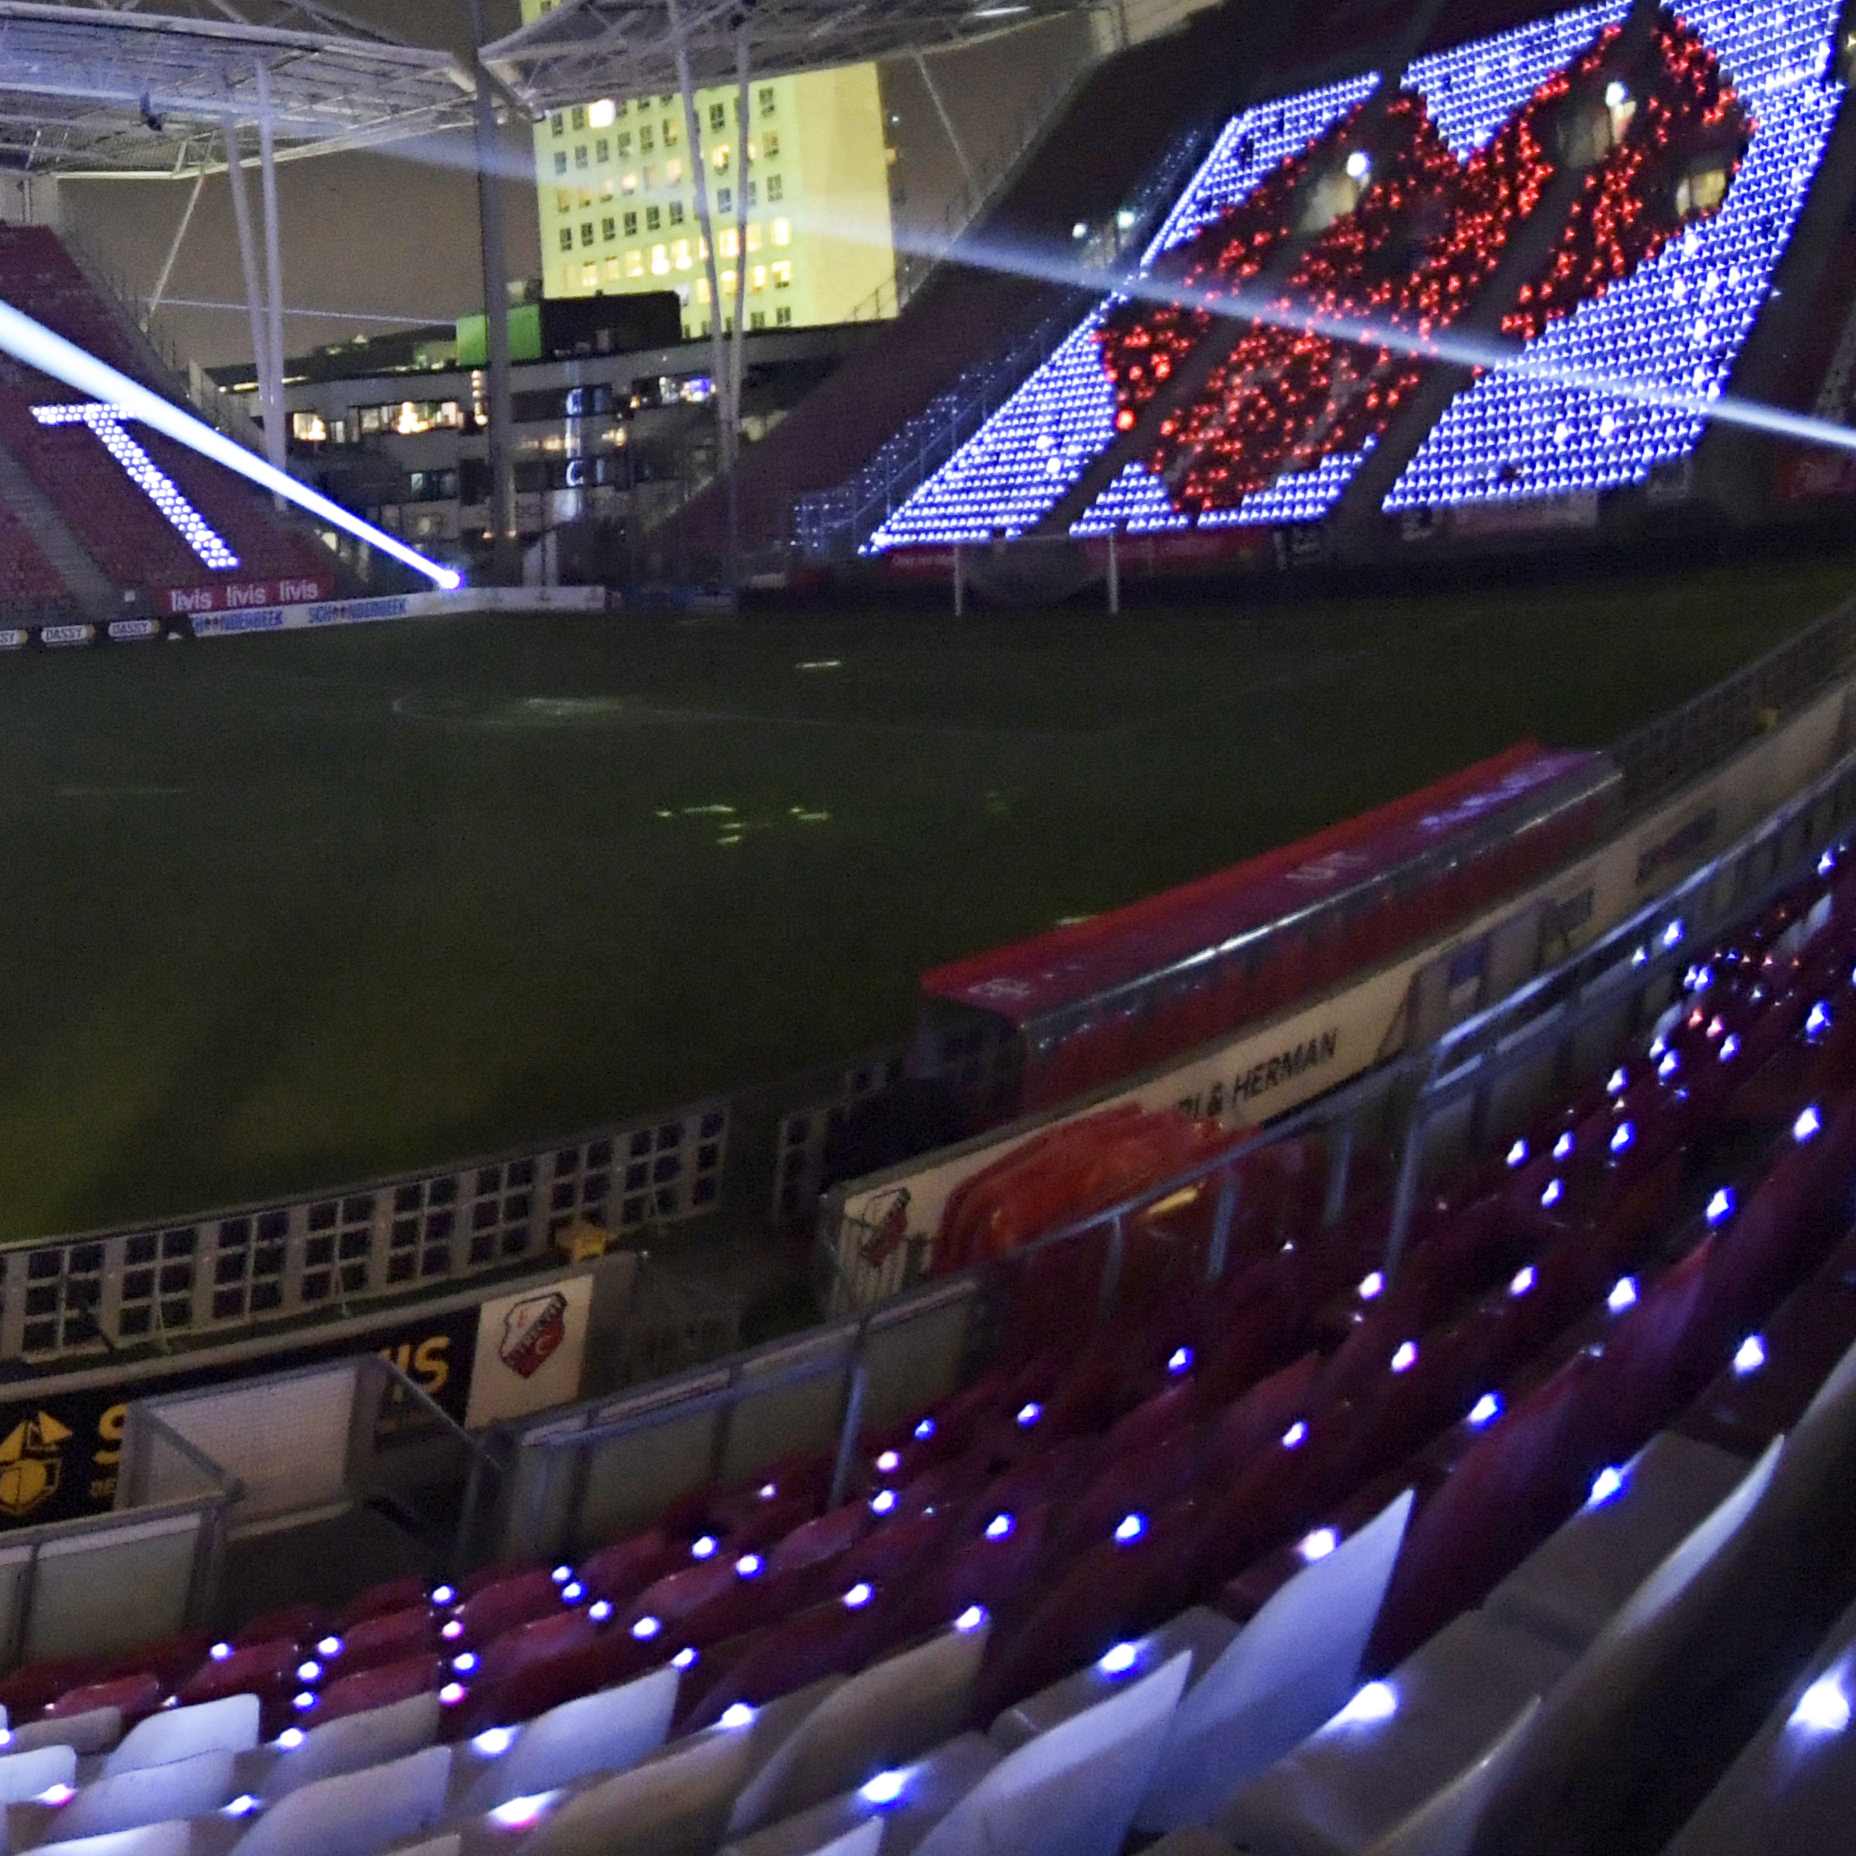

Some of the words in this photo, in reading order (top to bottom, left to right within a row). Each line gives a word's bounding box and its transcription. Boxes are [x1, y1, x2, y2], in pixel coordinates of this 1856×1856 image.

[44, 625, 85, 642] DASSY
[112, 621, 150, 636] DASSY
[1232, 1027, 1338, 1108] HERMAN
